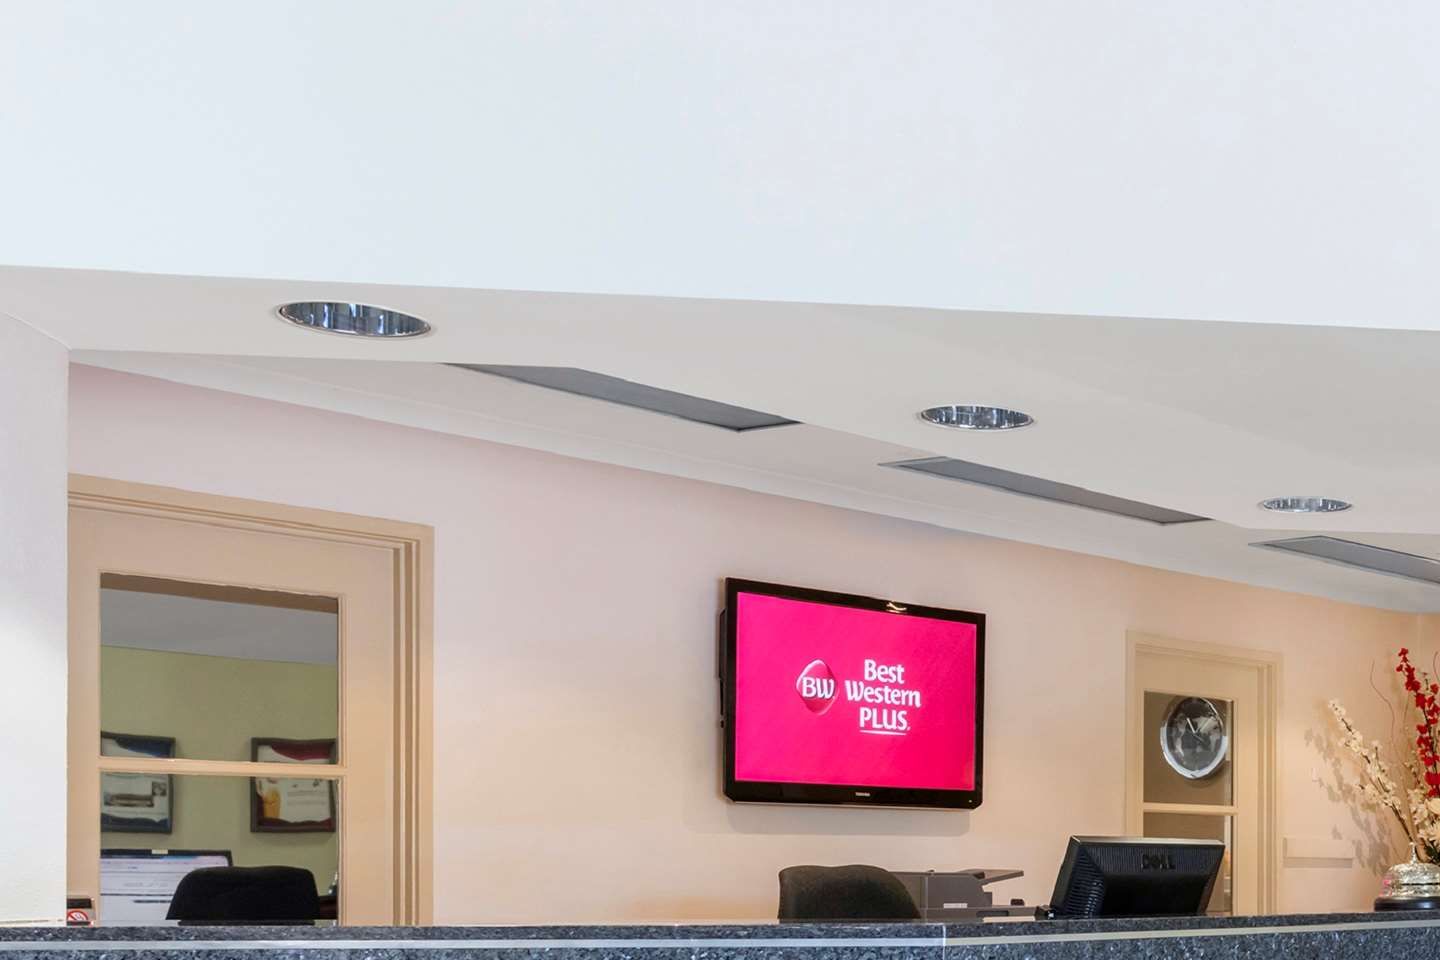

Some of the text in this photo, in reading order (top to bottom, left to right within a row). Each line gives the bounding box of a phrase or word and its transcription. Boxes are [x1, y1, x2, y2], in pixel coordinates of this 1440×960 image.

[864, 659, 905, 684] Best
[802, 676, 835, 699] BW
[845, 680, 921, 708] Western
[860, 707, 908, 731] PLUS
